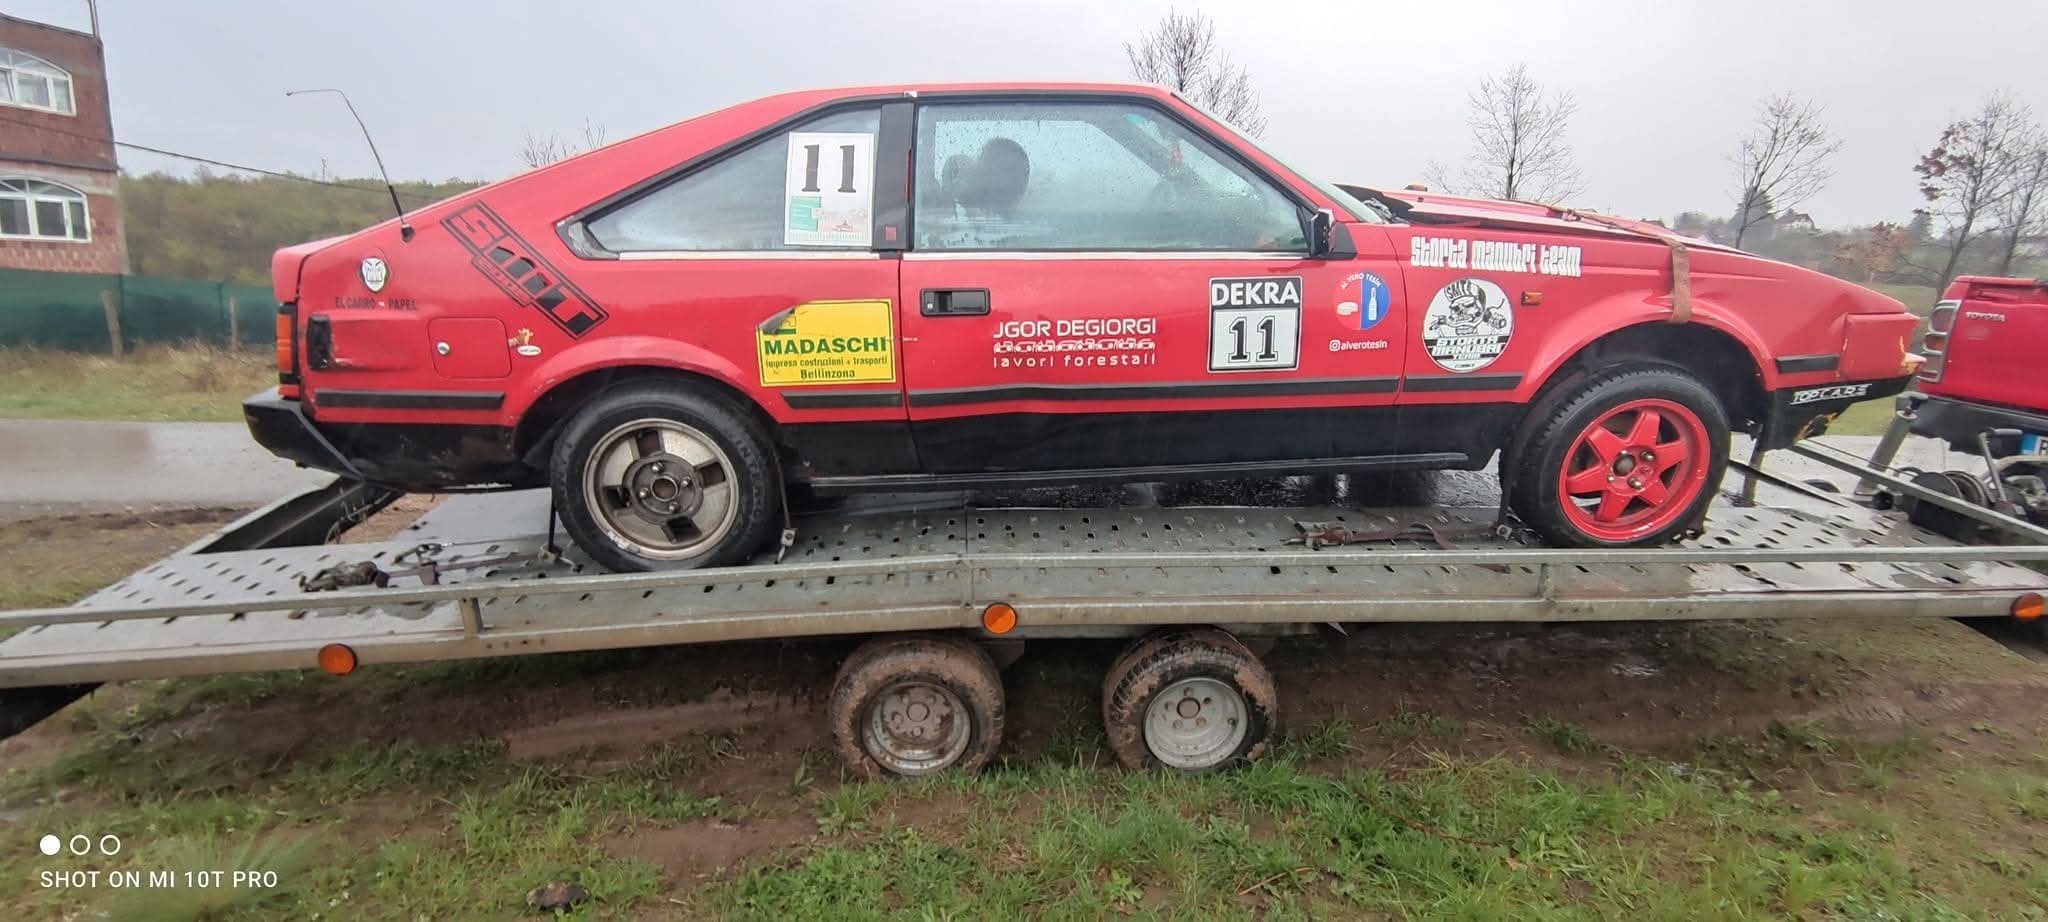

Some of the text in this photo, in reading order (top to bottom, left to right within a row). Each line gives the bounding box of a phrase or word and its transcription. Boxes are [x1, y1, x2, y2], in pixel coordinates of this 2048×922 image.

[801, 144, 856, 193] 11
[1211, 281, 1300, 306] DEKRA
[1057, 318, 1156, 336] DEGIORGI
[764, 336, 887, 355] MADASCHI
[1228, 316, 1278, 363] 11
[853, 356, 888, 366] trasporti
[1064, 353, 1155, 367] forestali
[800, 369, 855, 379] Bellinzona
